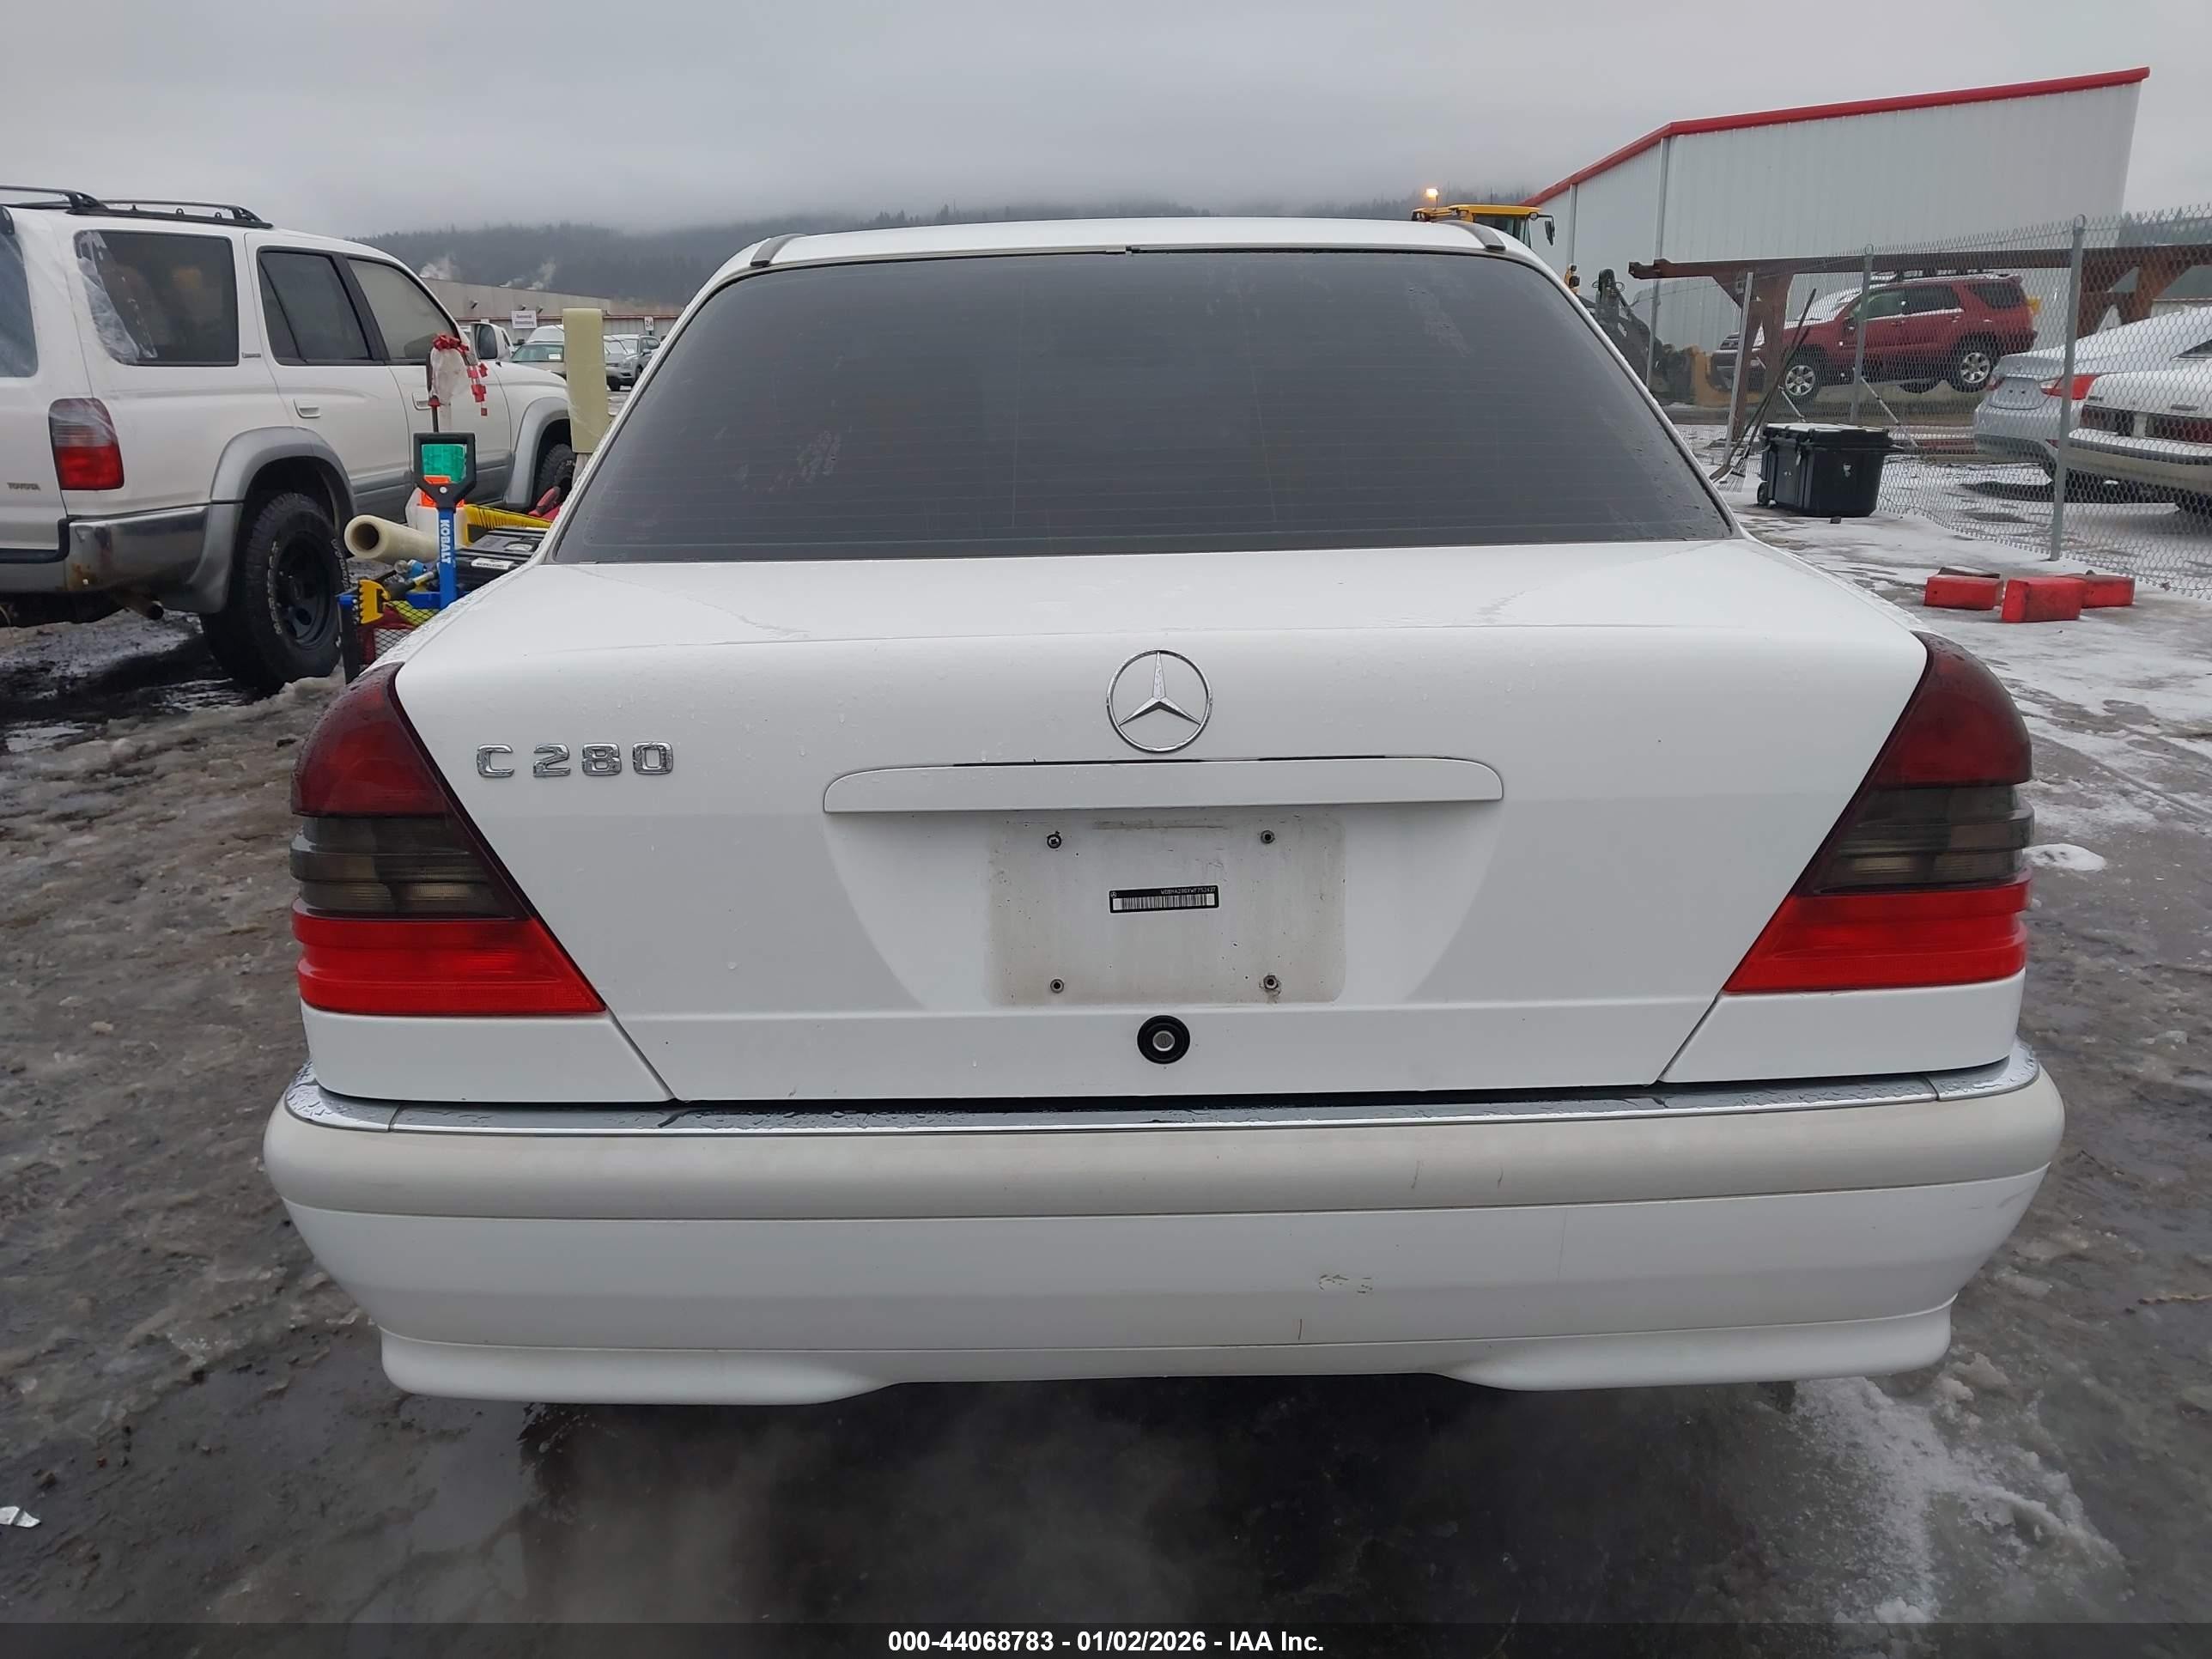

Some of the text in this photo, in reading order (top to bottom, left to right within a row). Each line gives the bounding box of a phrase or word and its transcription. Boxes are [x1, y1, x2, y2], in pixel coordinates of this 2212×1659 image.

[440, 519, 451, 563] KOBALT
[477, 741, 673, 778] C 280
